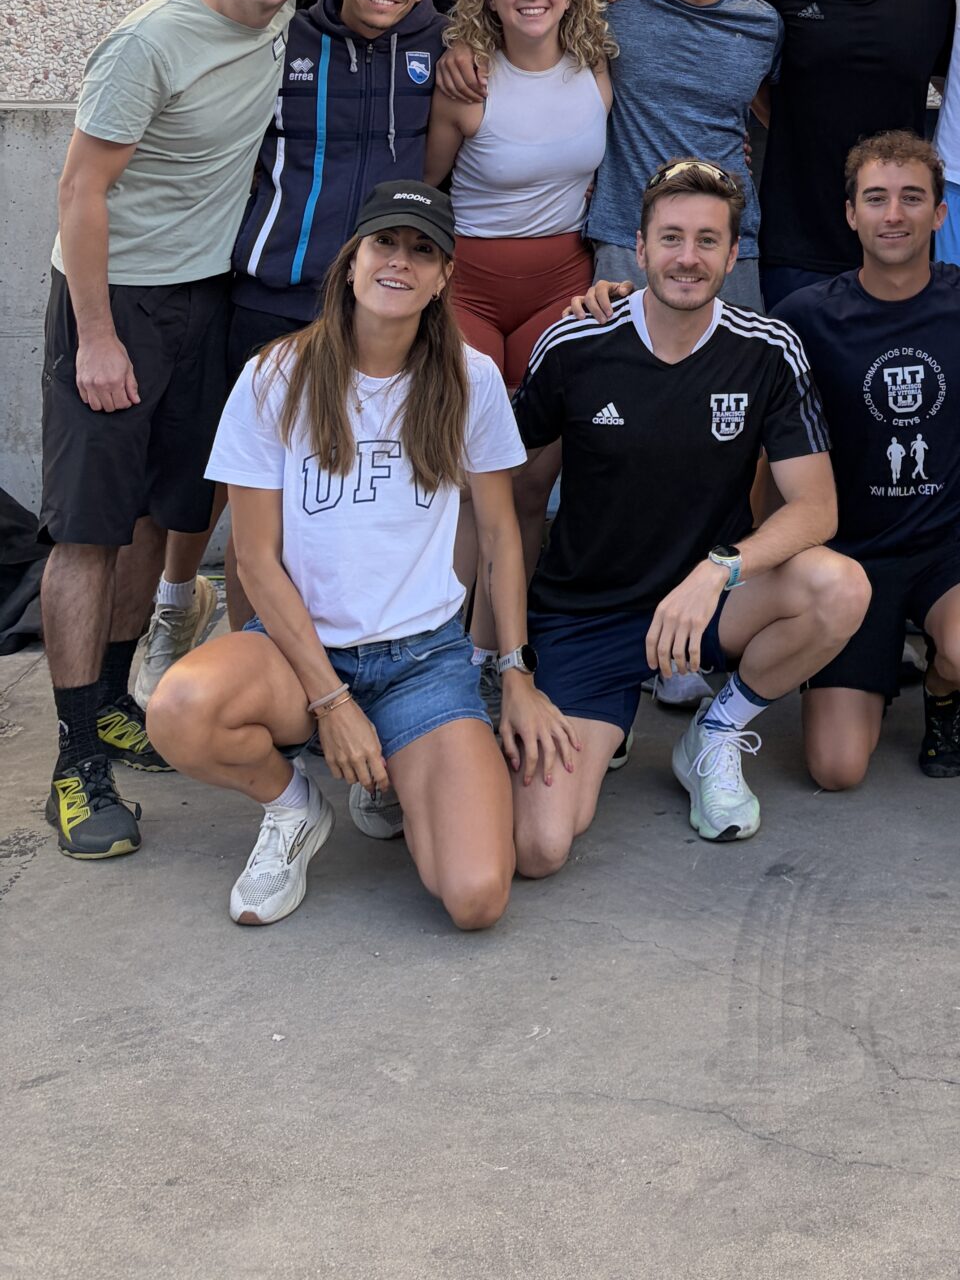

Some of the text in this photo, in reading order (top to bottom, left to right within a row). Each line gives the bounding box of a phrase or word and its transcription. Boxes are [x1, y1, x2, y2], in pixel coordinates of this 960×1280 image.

[393, 192, 433, 205] BROOKS
[863, 347, 946, 421] CICLOS FORMATIVOS DE GRADO SUPERIOR
[888, 383, 922, 391] FRANCISCO
[592, 416, 625, 426] adidas
[892, 416, 921, 427] CETYS
[869, 485, 885, 497] XVI
[887, 486, 917, 497] MILLA
